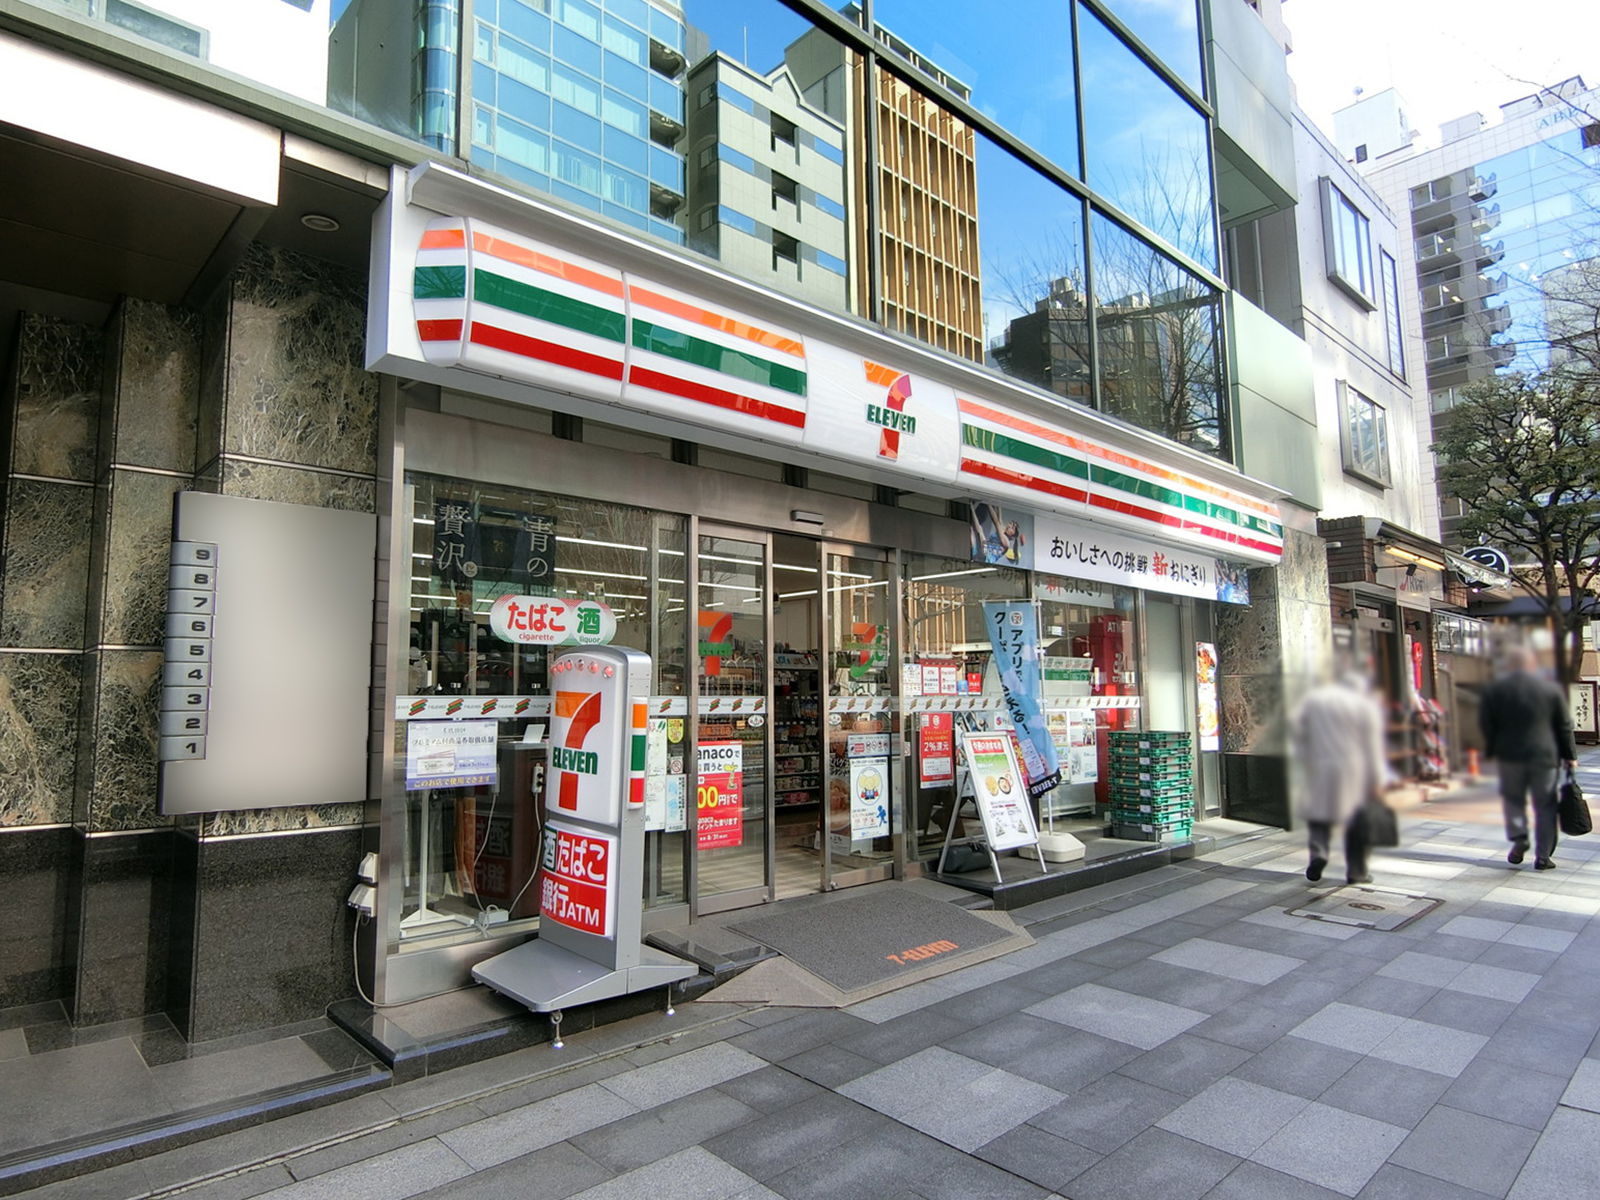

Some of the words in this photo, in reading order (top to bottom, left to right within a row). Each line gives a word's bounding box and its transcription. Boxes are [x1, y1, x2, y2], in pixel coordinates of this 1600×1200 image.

[195, 549, 210, 560] 9
[1050, 536, 1148, 575] おいしさへの挑戦
[194, 574, 208, 584] 8
[193, 597, 208, 608] 7
[507, 602, 566, 632] たばこ
[577, 606, 601, 634] 酒
[191, 621, 206, 631] 6
[518, 632, 554, 642] cigarette
[189, 645, 204, 656] 5
[188, 669, 203, 680] 4
[187, 694, 202, 705] 3
[185, 718, 201, 729] 2
[186, 742, 197, 753] 1
[555, 691, 602, 811] 7
[552, 746, 598, 775] ELEVEn
[557, 834, 606, 882] たばこ
